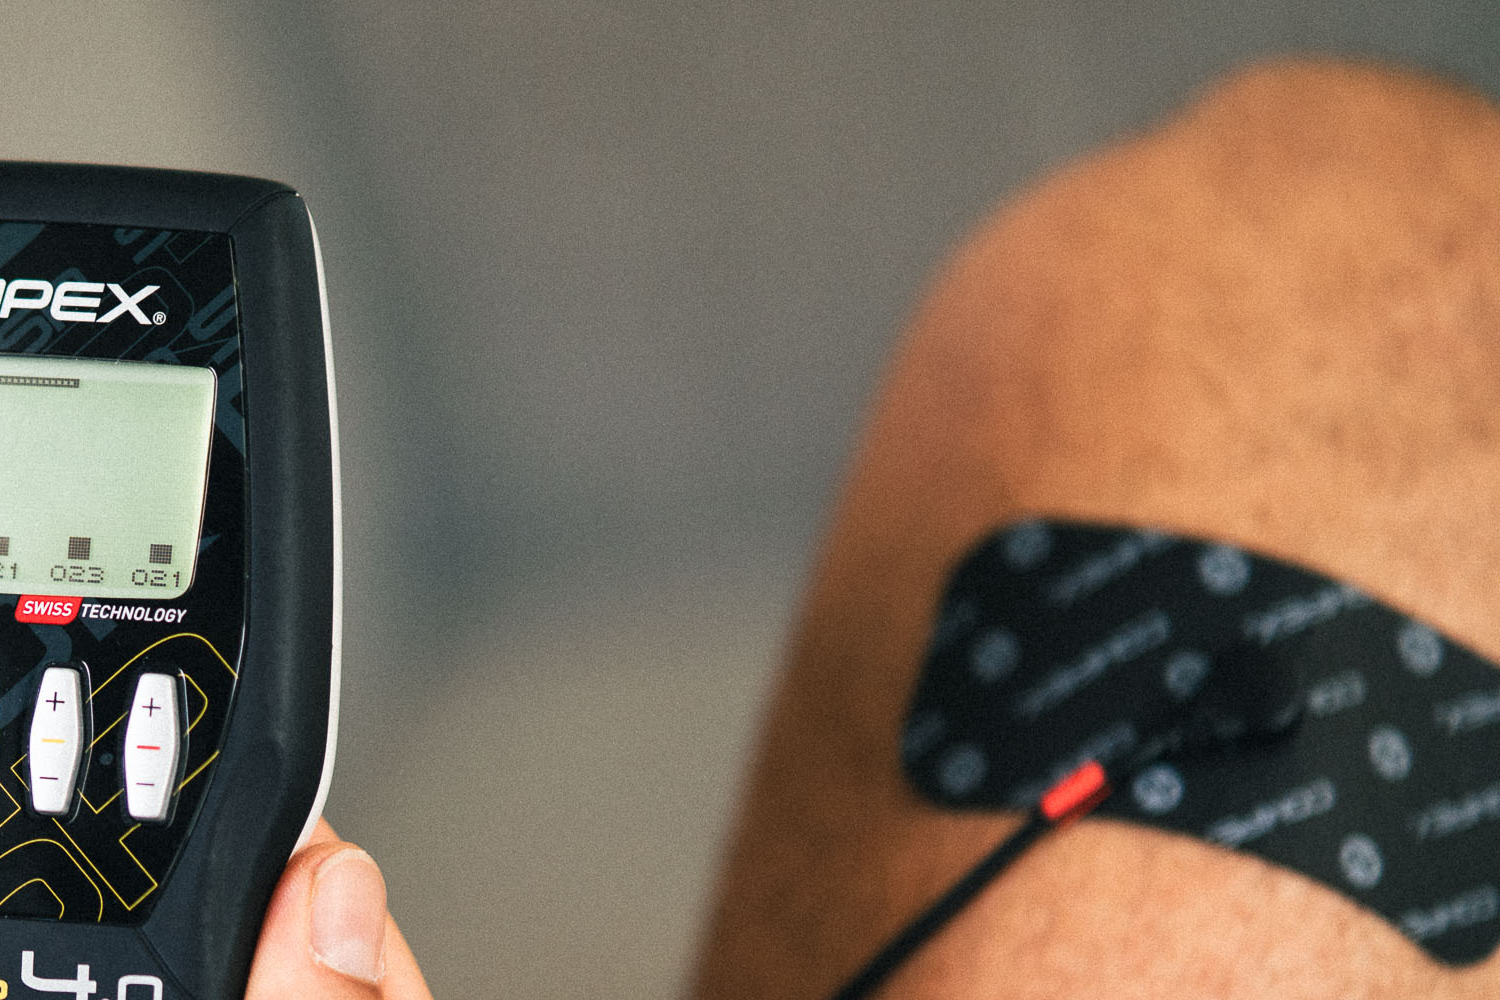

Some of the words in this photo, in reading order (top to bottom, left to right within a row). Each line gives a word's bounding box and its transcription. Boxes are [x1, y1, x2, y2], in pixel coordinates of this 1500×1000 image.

[51, 564, 104, 584] 023
[132, 568, 180, 588] 021
[22, 600, 74, 618] SWISS
[80, 602, 188, 624] TECHNOLOGY
